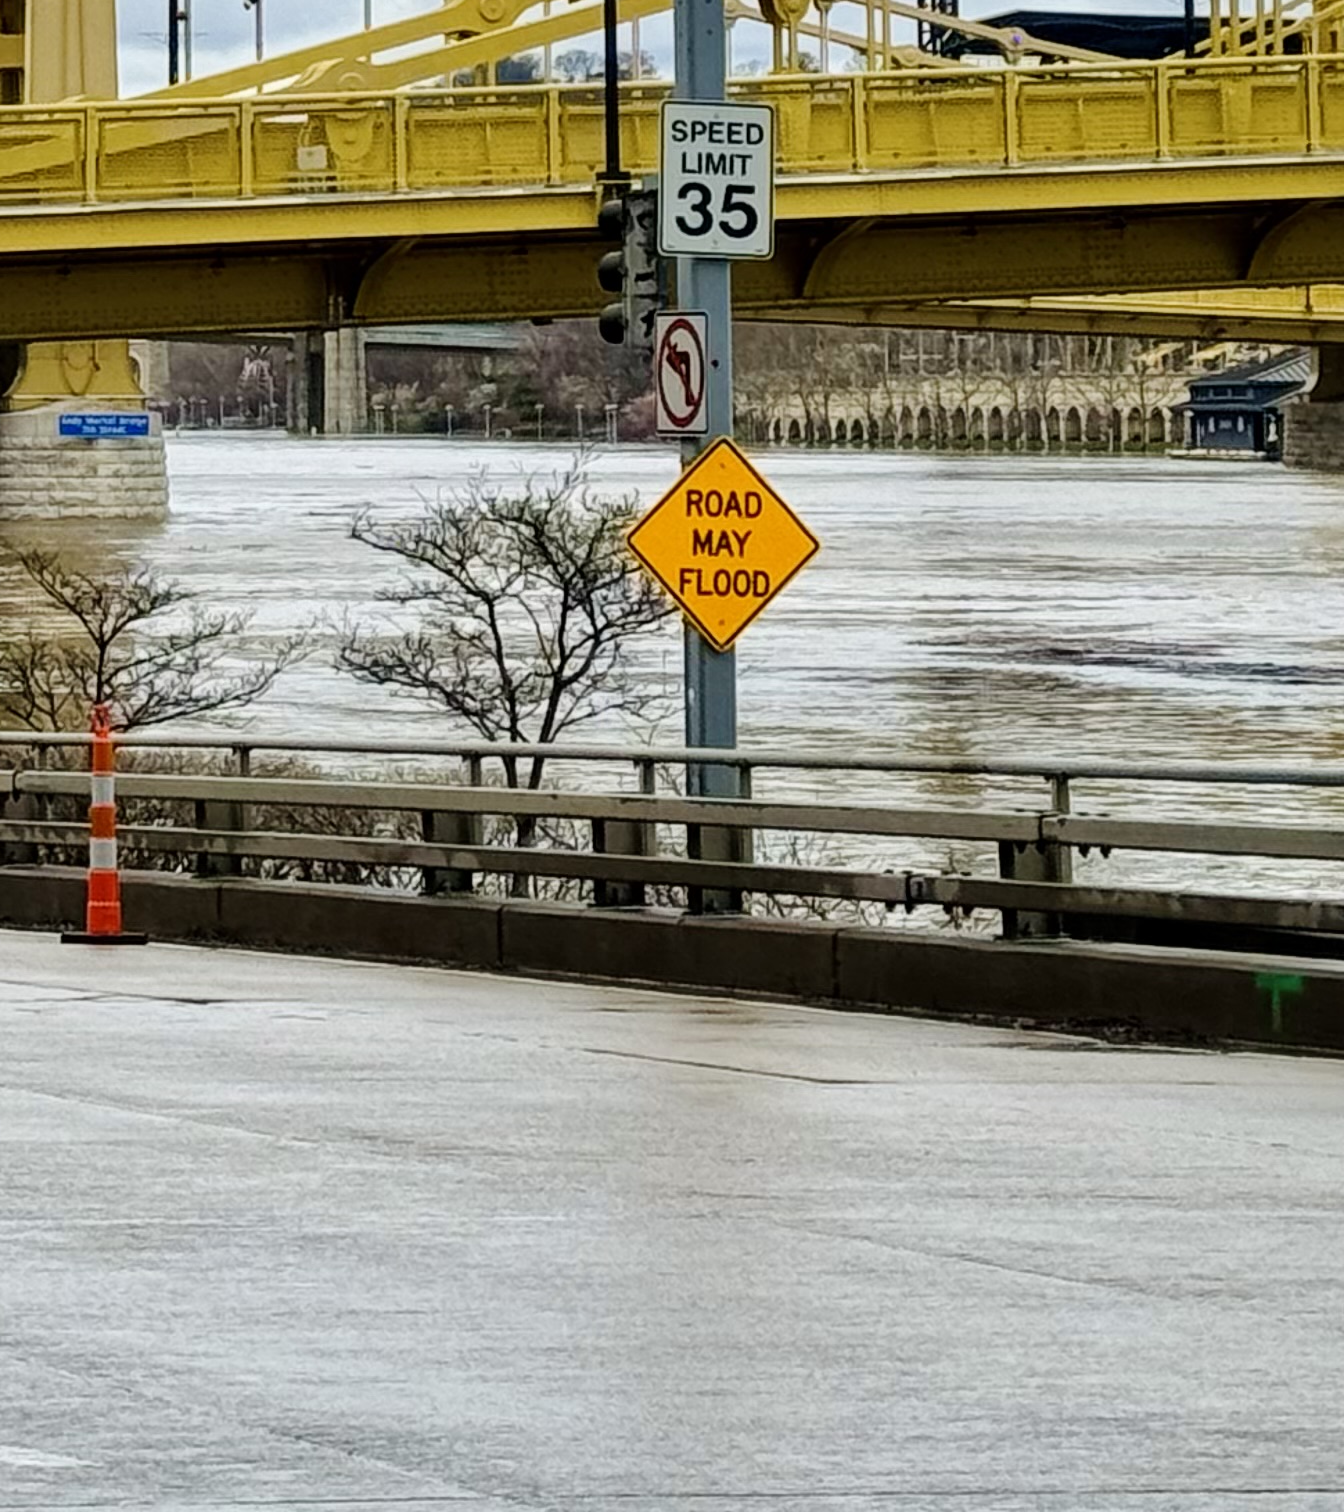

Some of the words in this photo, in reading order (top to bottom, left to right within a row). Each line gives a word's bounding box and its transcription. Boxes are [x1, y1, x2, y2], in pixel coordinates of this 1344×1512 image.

[671, 119, 765, 147] SPEED
[681, 152, 753, 177] LIMIT
[675, 182, 759, 239] 35
[685, 489, 763, 519] ROAD
[692, 529, 752, 558] MAY
[678, 568, 771, 599] FLOOD
